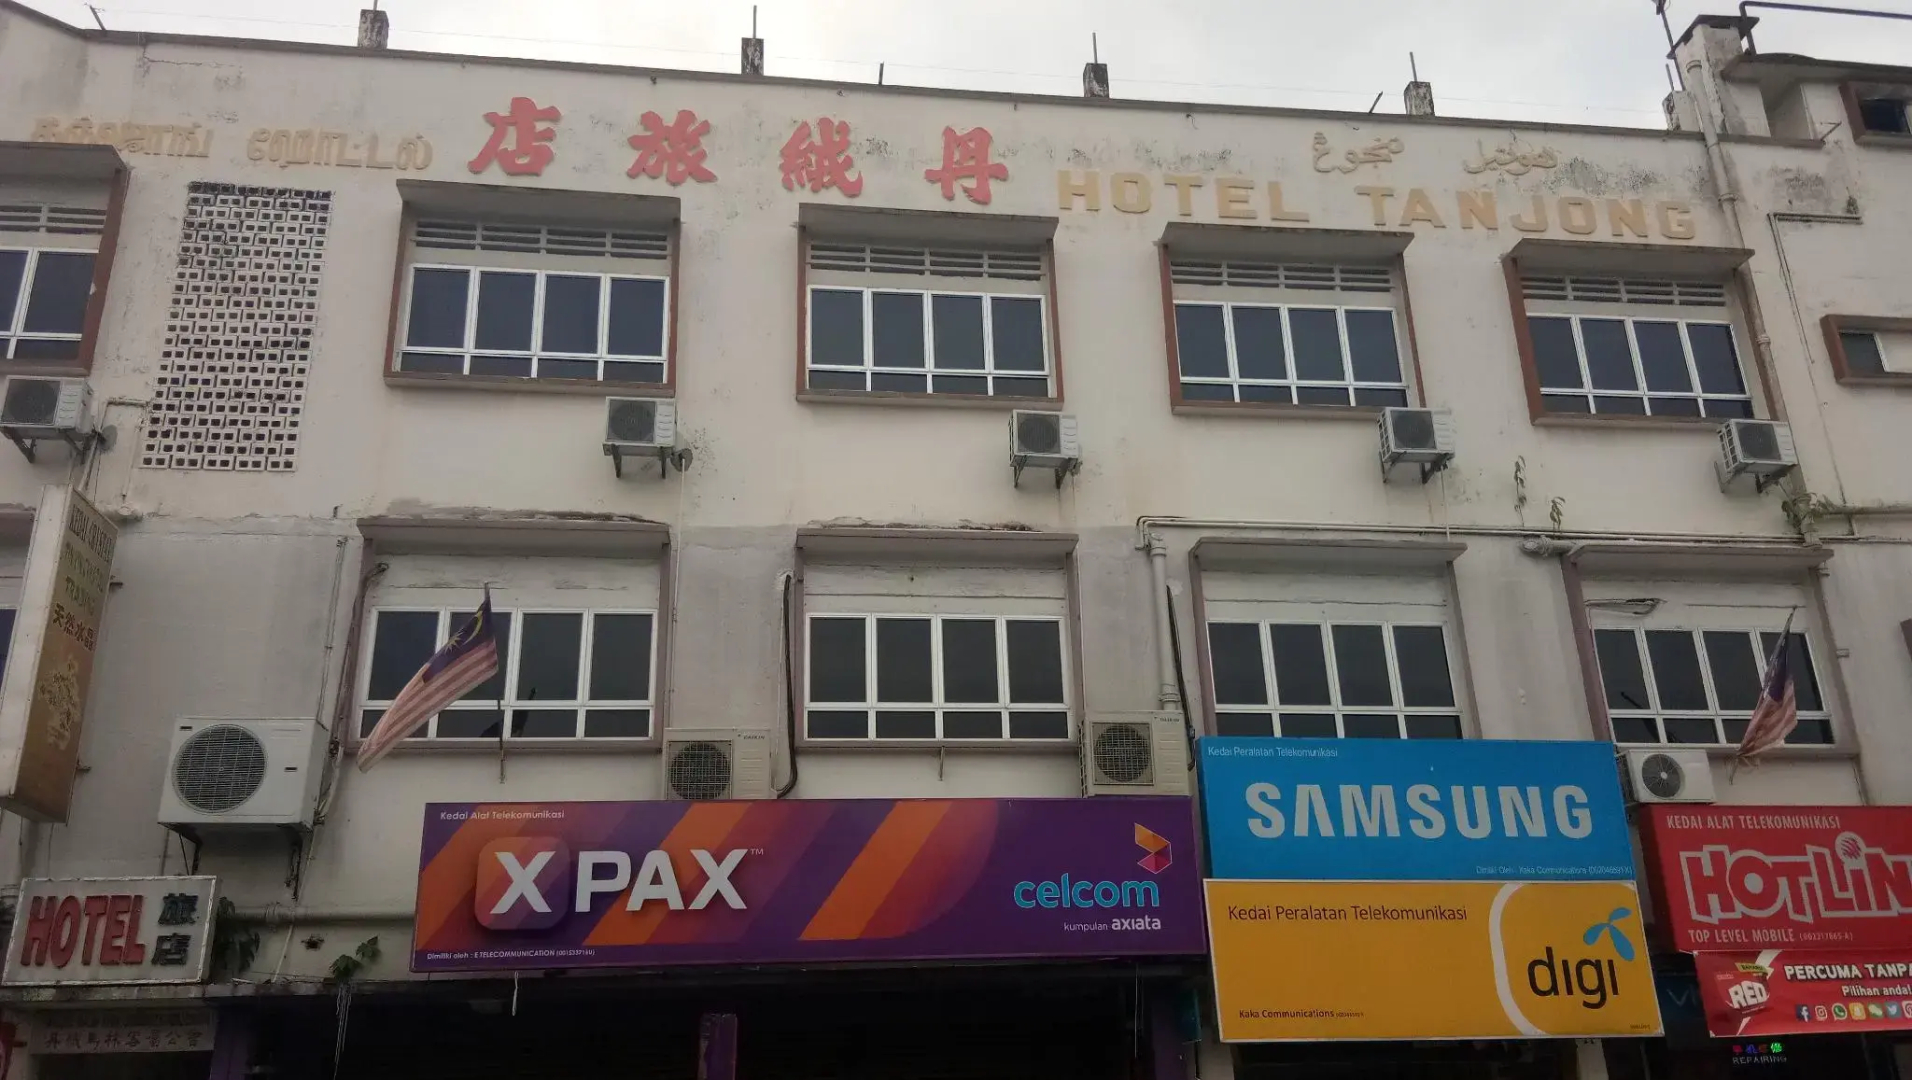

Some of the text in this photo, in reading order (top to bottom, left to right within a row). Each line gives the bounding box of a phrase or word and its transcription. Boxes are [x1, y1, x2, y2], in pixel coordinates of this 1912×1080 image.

[1057, 169, 1695, 240] HOTEL TANJONG
[52, 602, 95, 651] 天然水晶
[1207, 746, 1338, 757] Kedai Peralatan Telekomunikasi
[440, 809, 565, 820] Kedai Alat Telekomunikasi
[1245, 782, 1593, 839] SAMSUNG
[1666, 815, 1841, 830] KEDAI ALAT TELEKOMUNIKASI
[1013, 873, 1160, 908] celcom
[1228, 904, 1468, 922] Kedai Peralatan Telekomunikasi
[20, 895, 146, 968] HOTEL
[151, 892, 199, 966] 旅店
[1063, 915, 1161, 933] kumpulan axiata
[1688, 930, 1710, 943] TOP
[1715, 929, 1749, 943] LEVEL
[1752, 928, 1795, 943] MOBILE
[1527, 946, 1619, 1010] digi
[1784, 962, 1912, 980] PERCUMA TANP
[1728, 980, 1768, 1009] RED
[1842, 984, 1880, 997] Pilihan
[1239, 1009, 1259, 1018] Kaka
[1262, 1009, 1334, 1018] Communications
